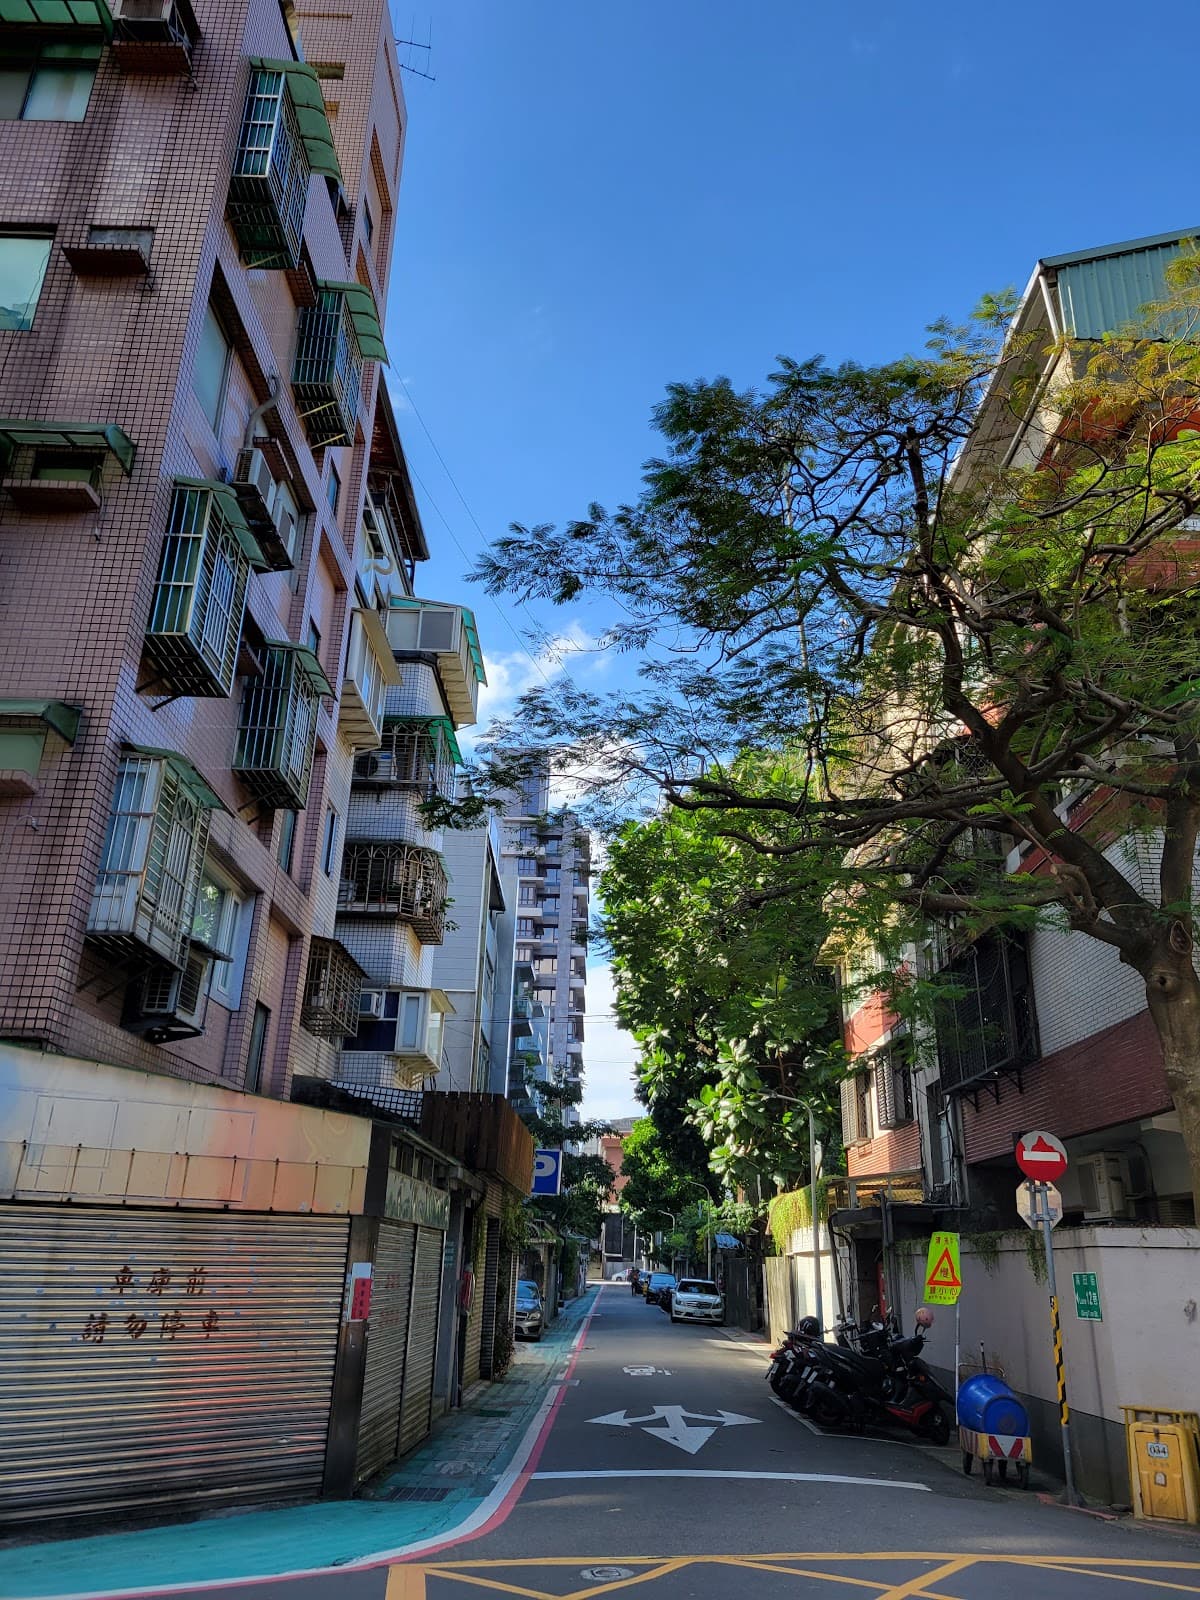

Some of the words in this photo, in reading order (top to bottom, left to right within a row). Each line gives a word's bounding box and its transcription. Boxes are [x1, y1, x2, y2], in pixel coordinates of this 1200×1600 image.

[110, 1265, 209, 1296] 車庫前
[82, 1309, 220, 1344] 請勿停車
